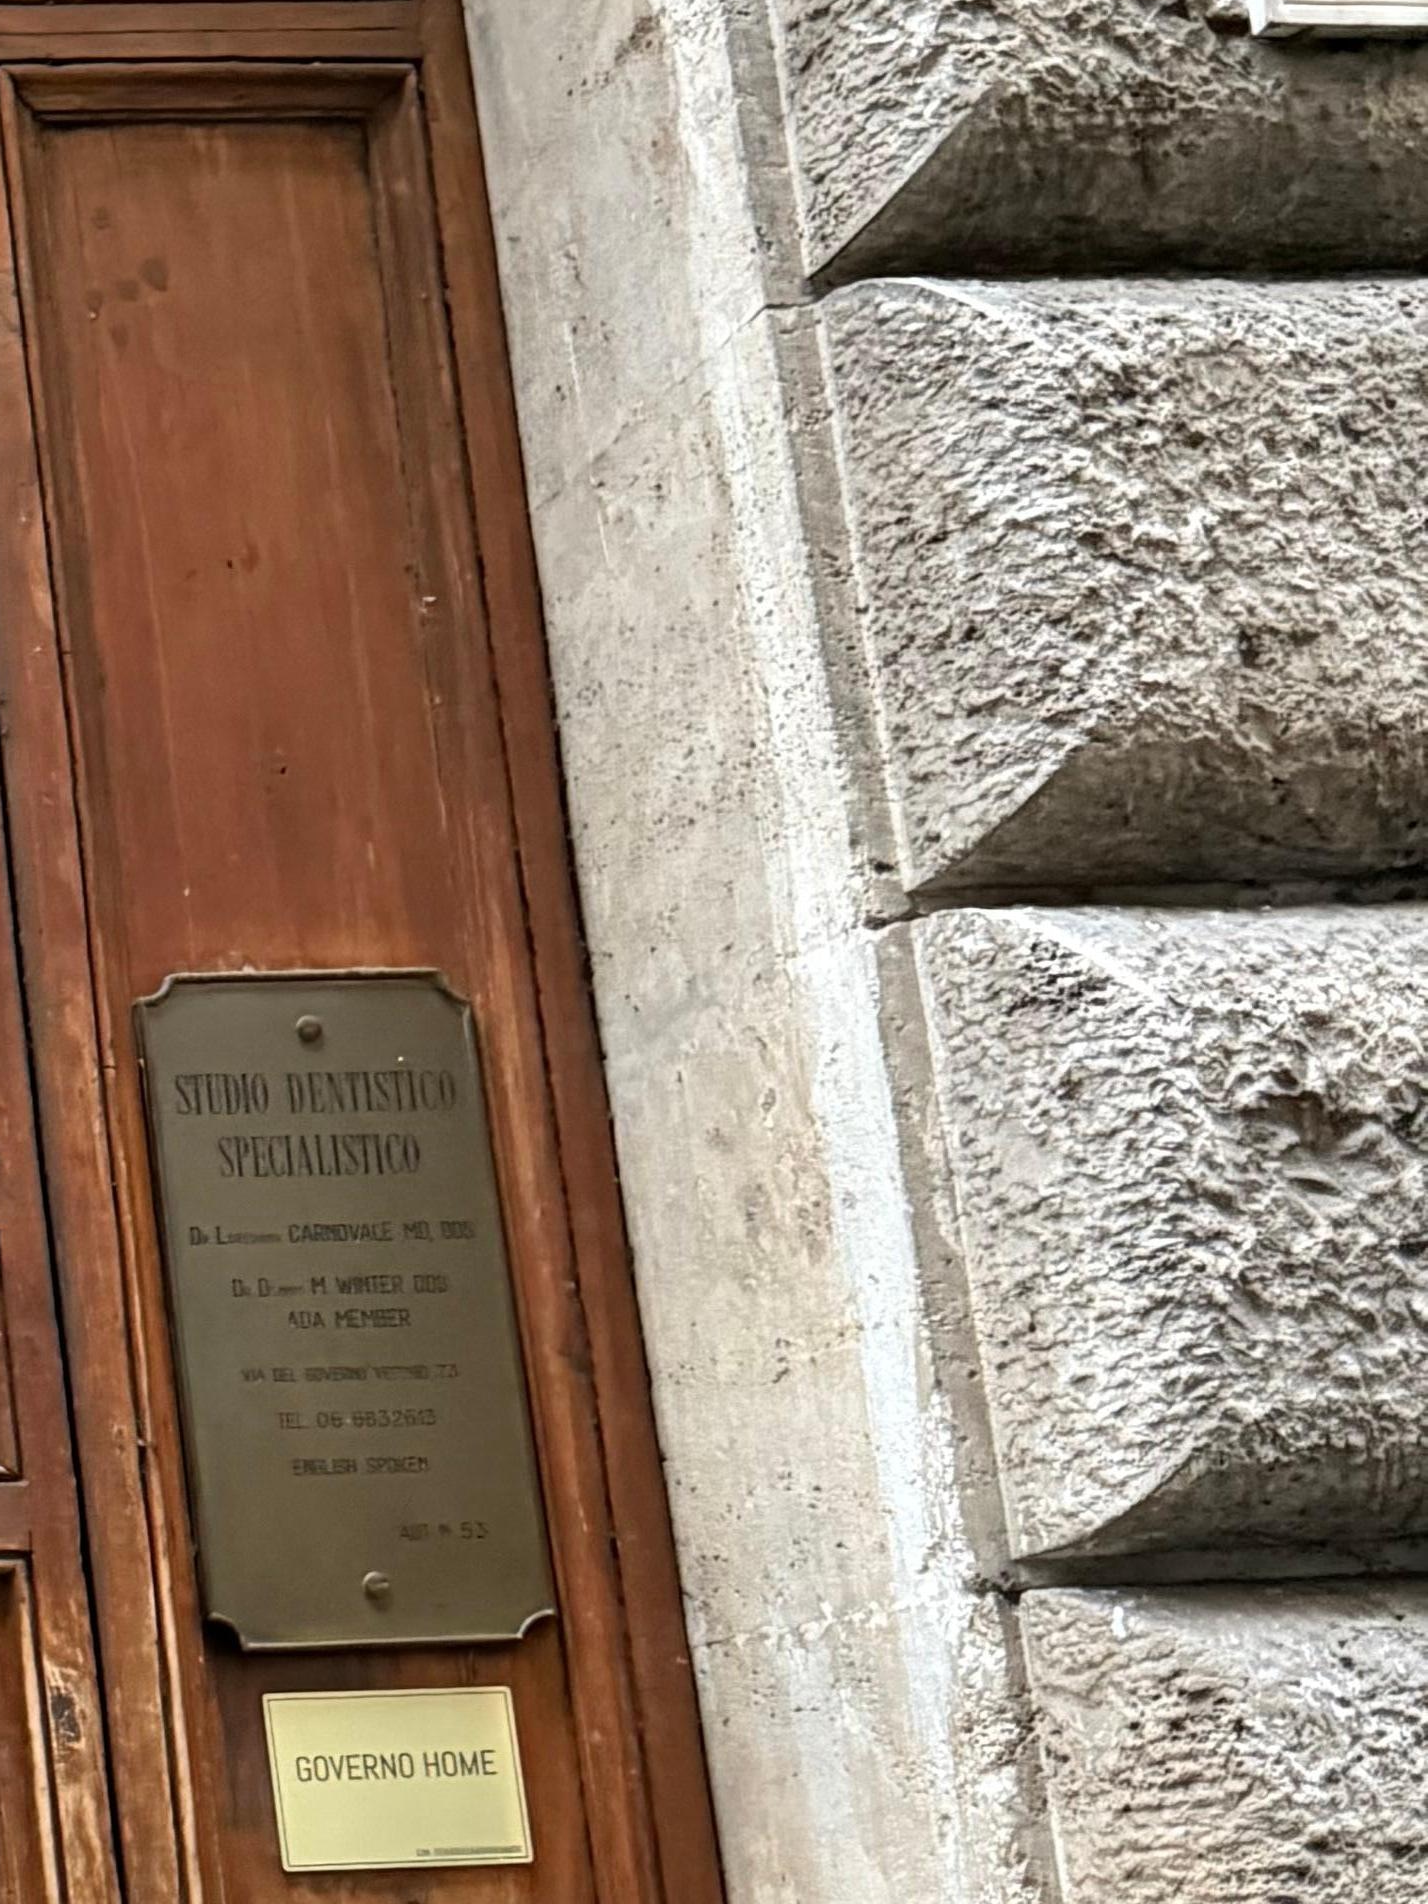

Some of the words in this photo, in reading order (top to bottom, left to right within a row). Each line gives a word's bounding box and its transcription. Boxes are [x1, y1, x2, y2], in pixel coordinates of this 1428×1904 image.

[174, 1072, 270, 1116] STUDIO
[286, 1068, 457, 1114] DENTISTICO
[217, 1133, 422, 1179] SPECIALISTICO
[287, 1220, 395, 1244] CARNOVALE
[334, 1274, 405, 1295] WINTER
[287, 1309, 327, 1329] ADA
[334, 1307, 412, 1328] MEMBER
[292, 1457, 359, 1476] ENGLISH
[364, 1456, 430, 1474] SPOKEN
[295, 1751, 415, 1783] GOVERNO
[422, 1749, 498, 1778] HOME
